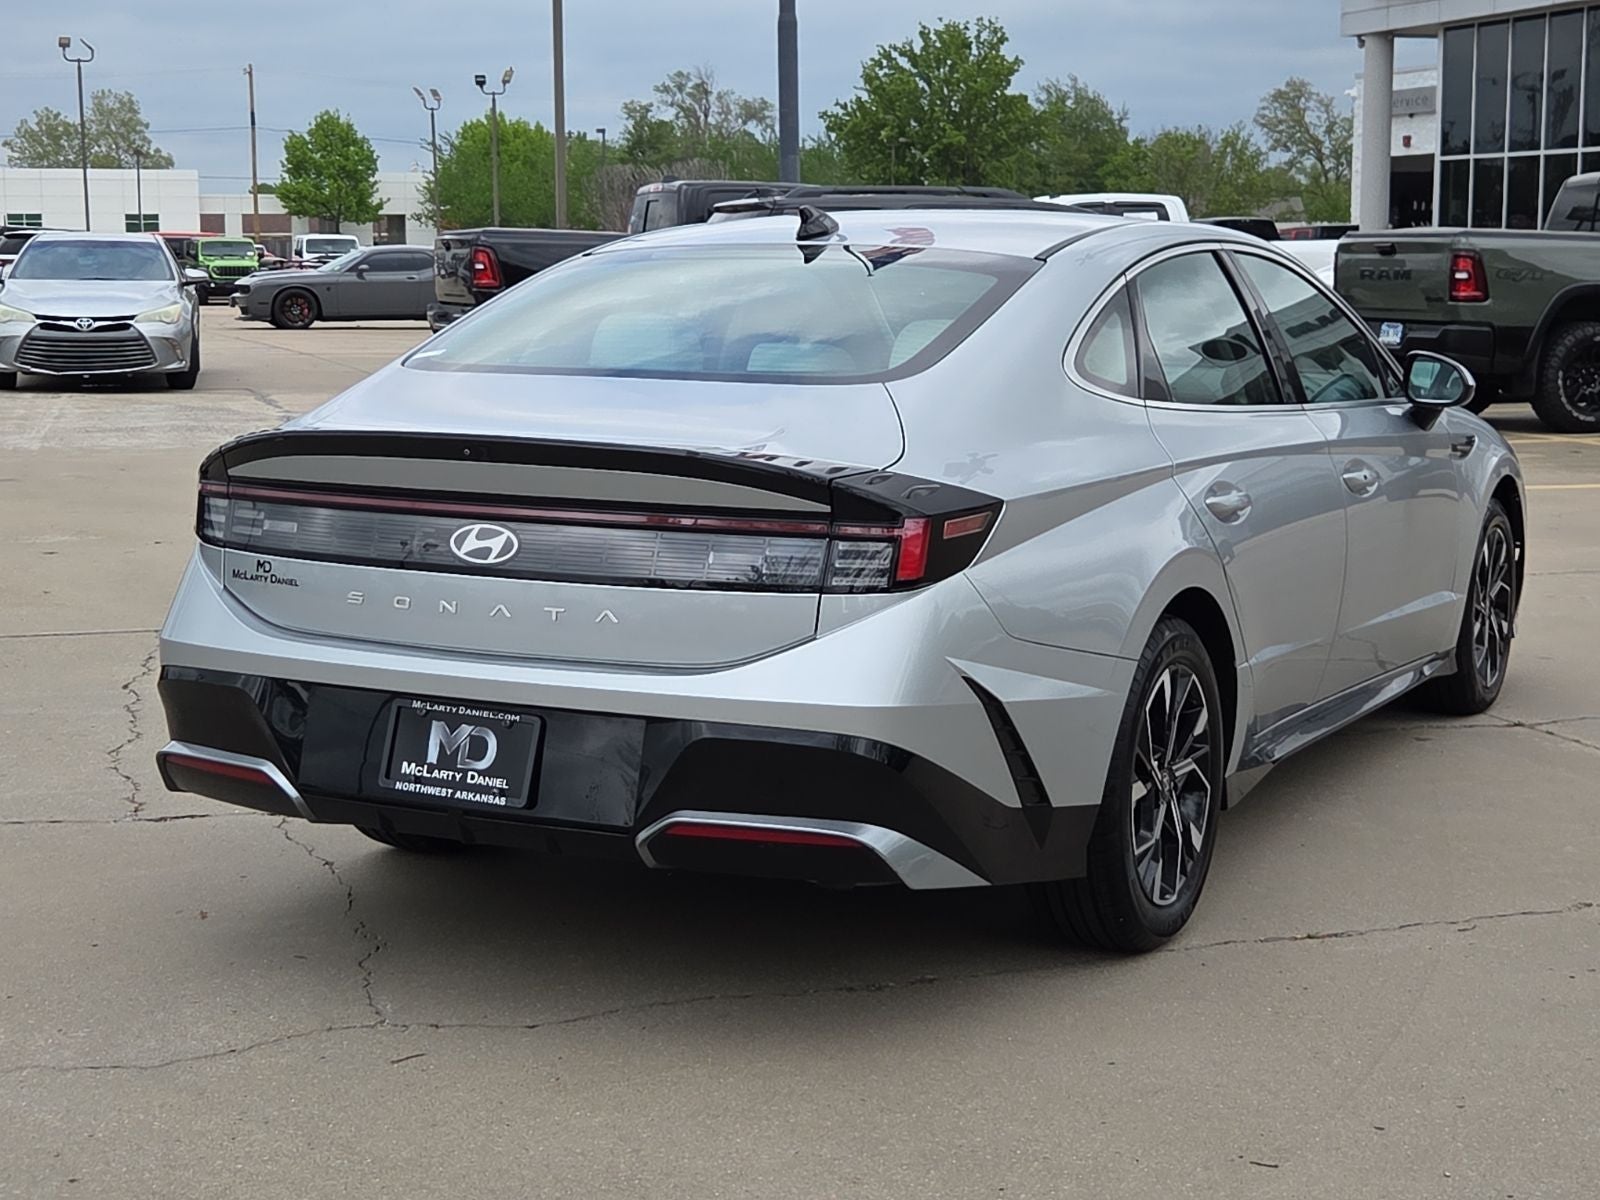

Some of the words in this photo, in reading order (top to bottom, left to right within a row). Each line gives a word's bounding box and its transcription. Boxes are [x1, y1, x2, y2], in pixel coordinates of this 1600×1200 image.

[1393, 94, 1429, 109] ervice
[1359, 267, 1412, 281] RAM
[347, 591, 619, 624] SONATA
[395, 781, 453, 797] NORTHWEST
[454, 790, 507, 806] ARKANSAS
